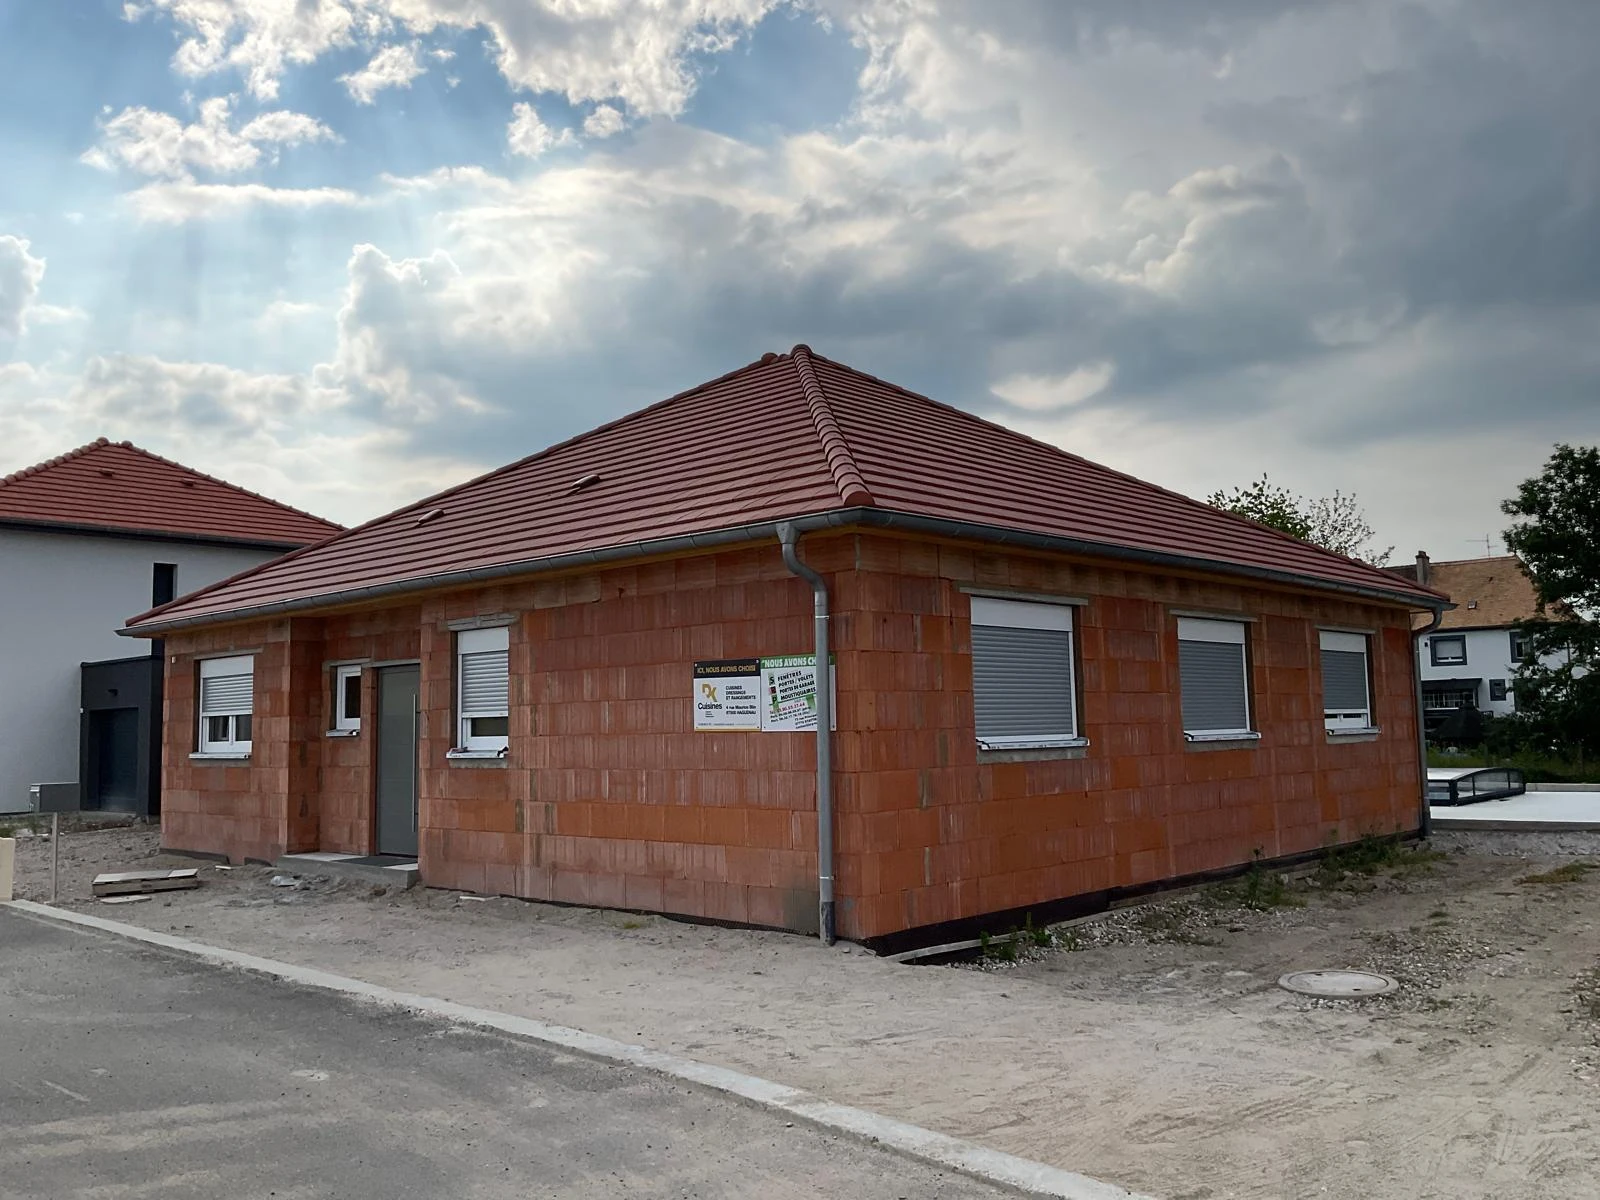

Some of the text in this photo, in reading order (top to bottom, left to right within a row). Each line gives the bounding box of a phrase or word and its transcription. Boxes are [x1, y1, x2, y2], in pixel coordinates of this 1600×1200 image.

[784, 657, 807, 667] AVONS
[720, 665, 738, 673] AVONS
[778, 679, 795, 688] PORTES
[798, 673, 814, 682] VOLETS
[780, 686, 816, 700] MOUSTIQUAIRES
[698, 702, 722, 710] Cuisines
